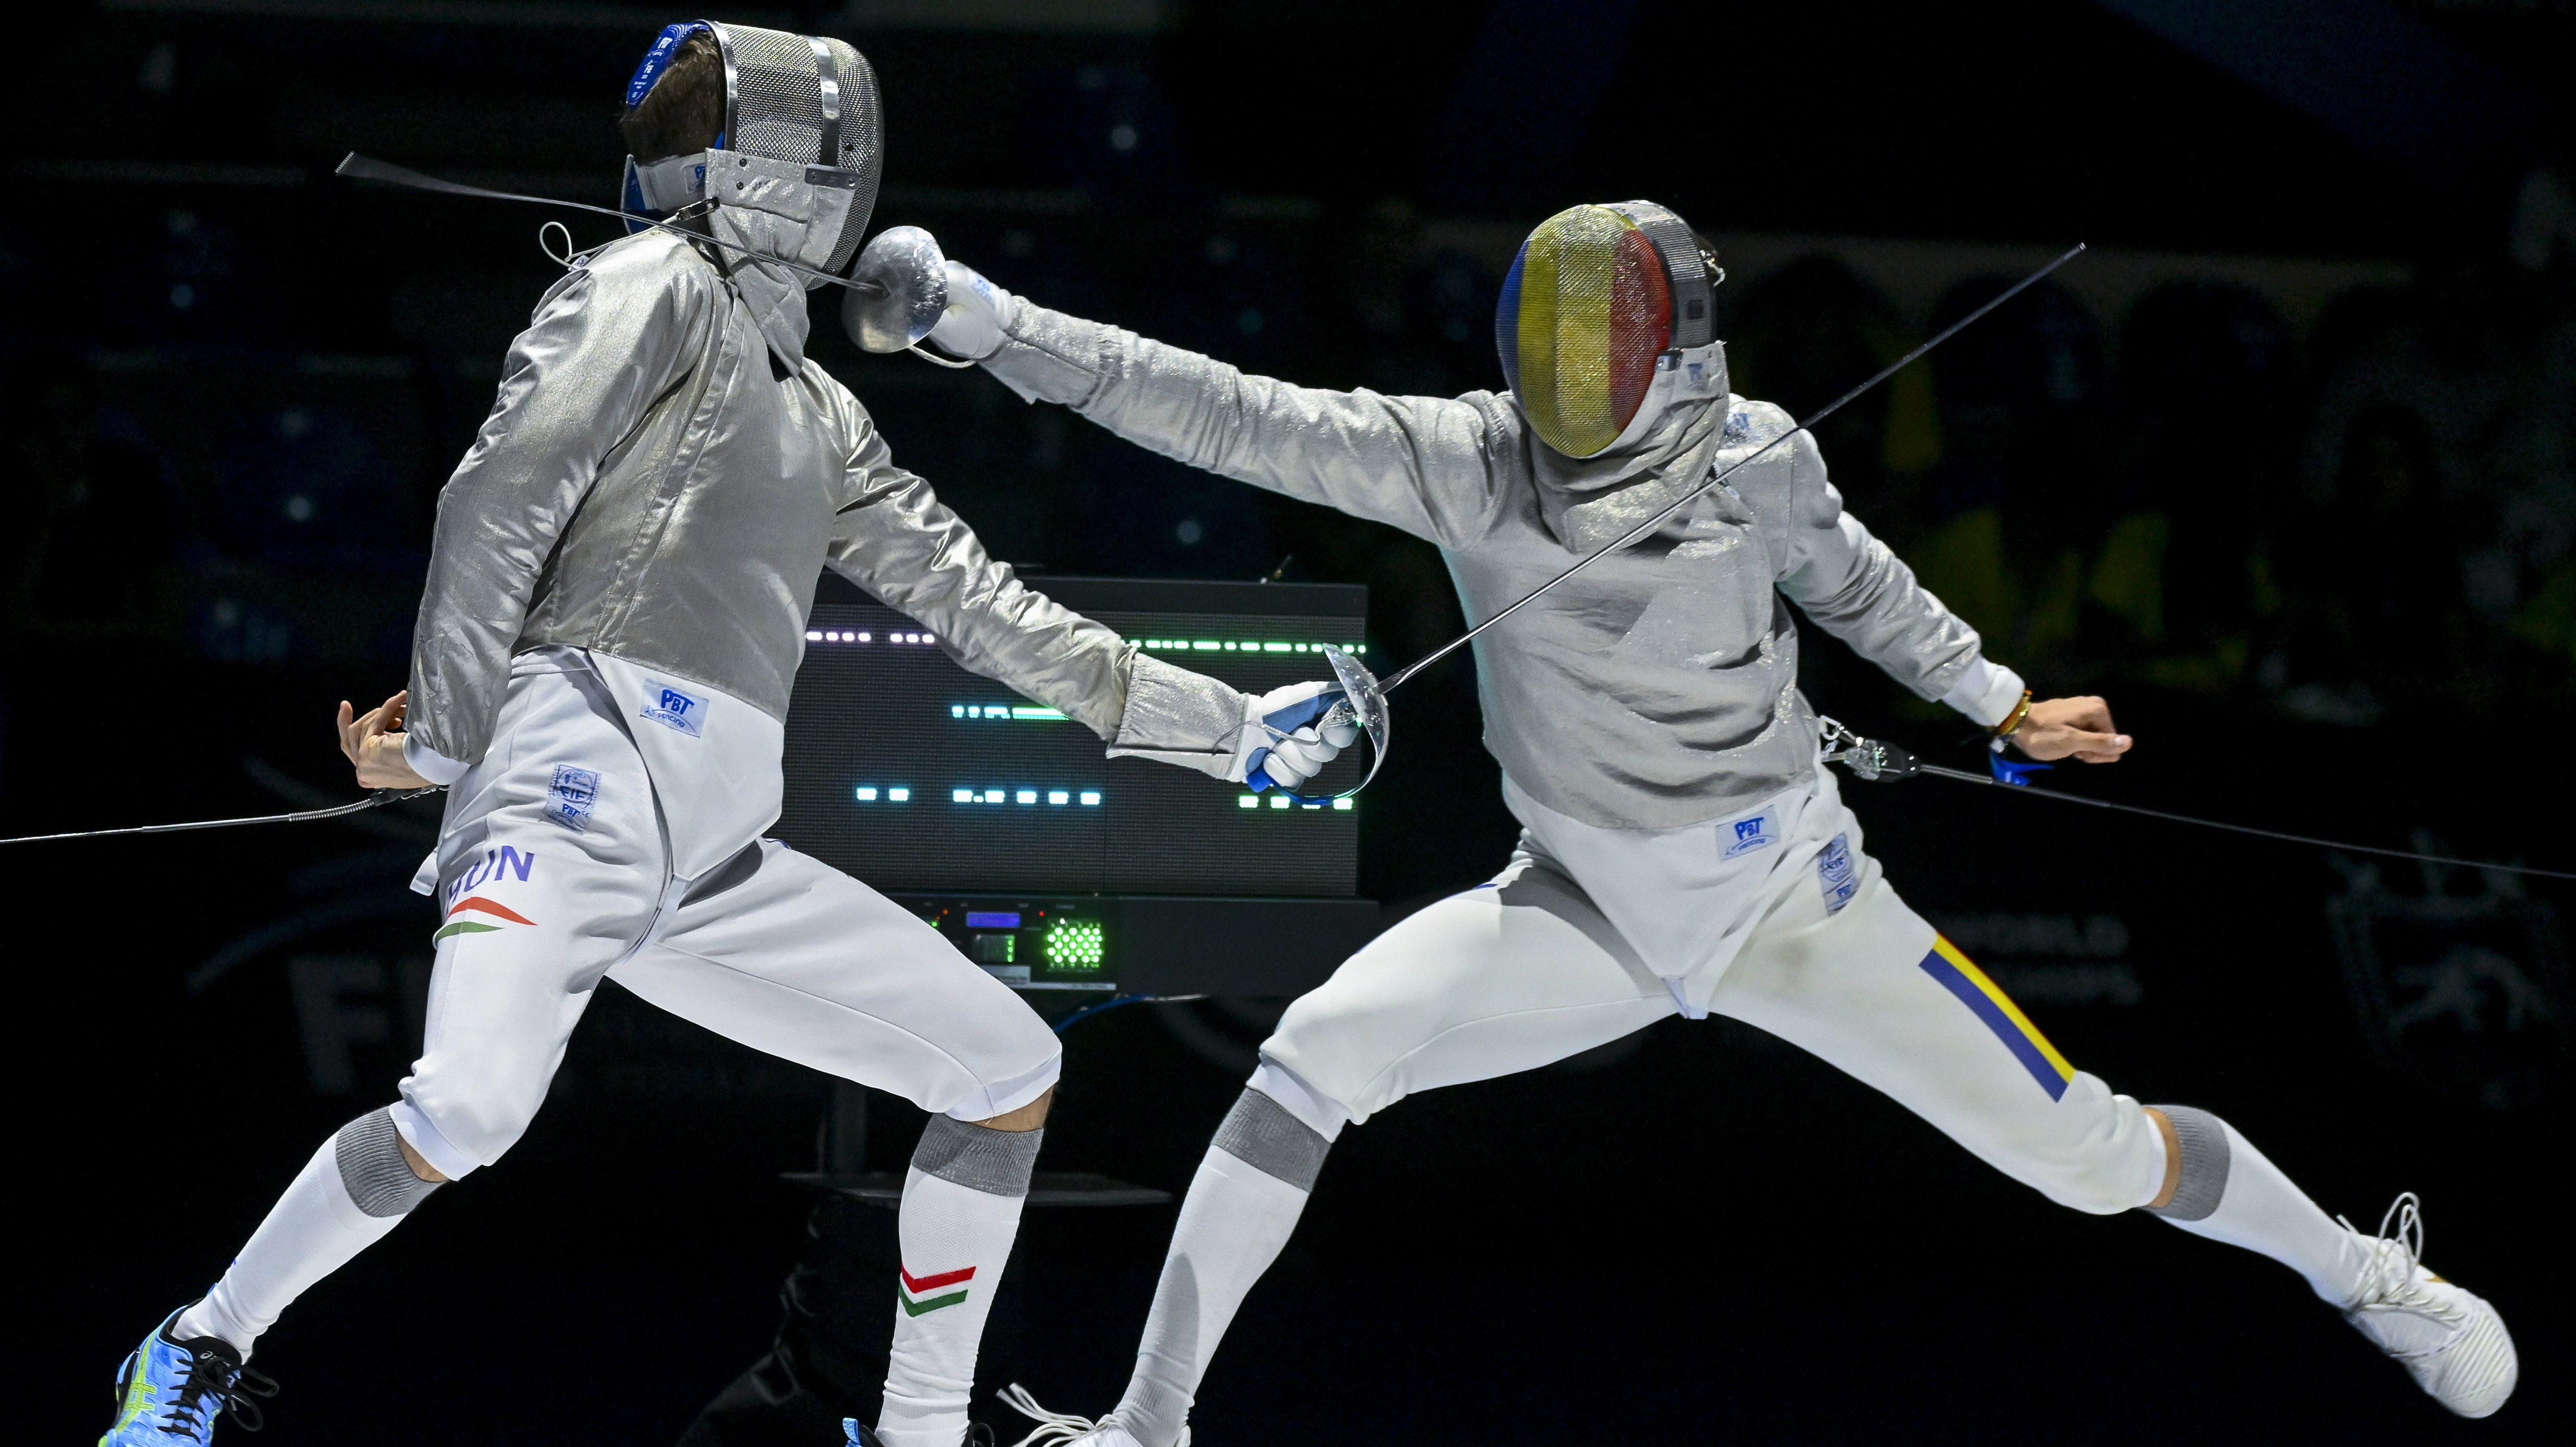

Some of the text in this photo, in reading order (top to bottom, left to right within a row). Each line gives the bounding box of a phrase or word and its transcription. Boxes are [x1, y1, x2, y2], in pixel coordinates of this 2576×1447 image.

[660, 689, 695, 715] PBT
[562, 803, 581, 817] PBT
[1734, 817, 1764, 841] PBT
